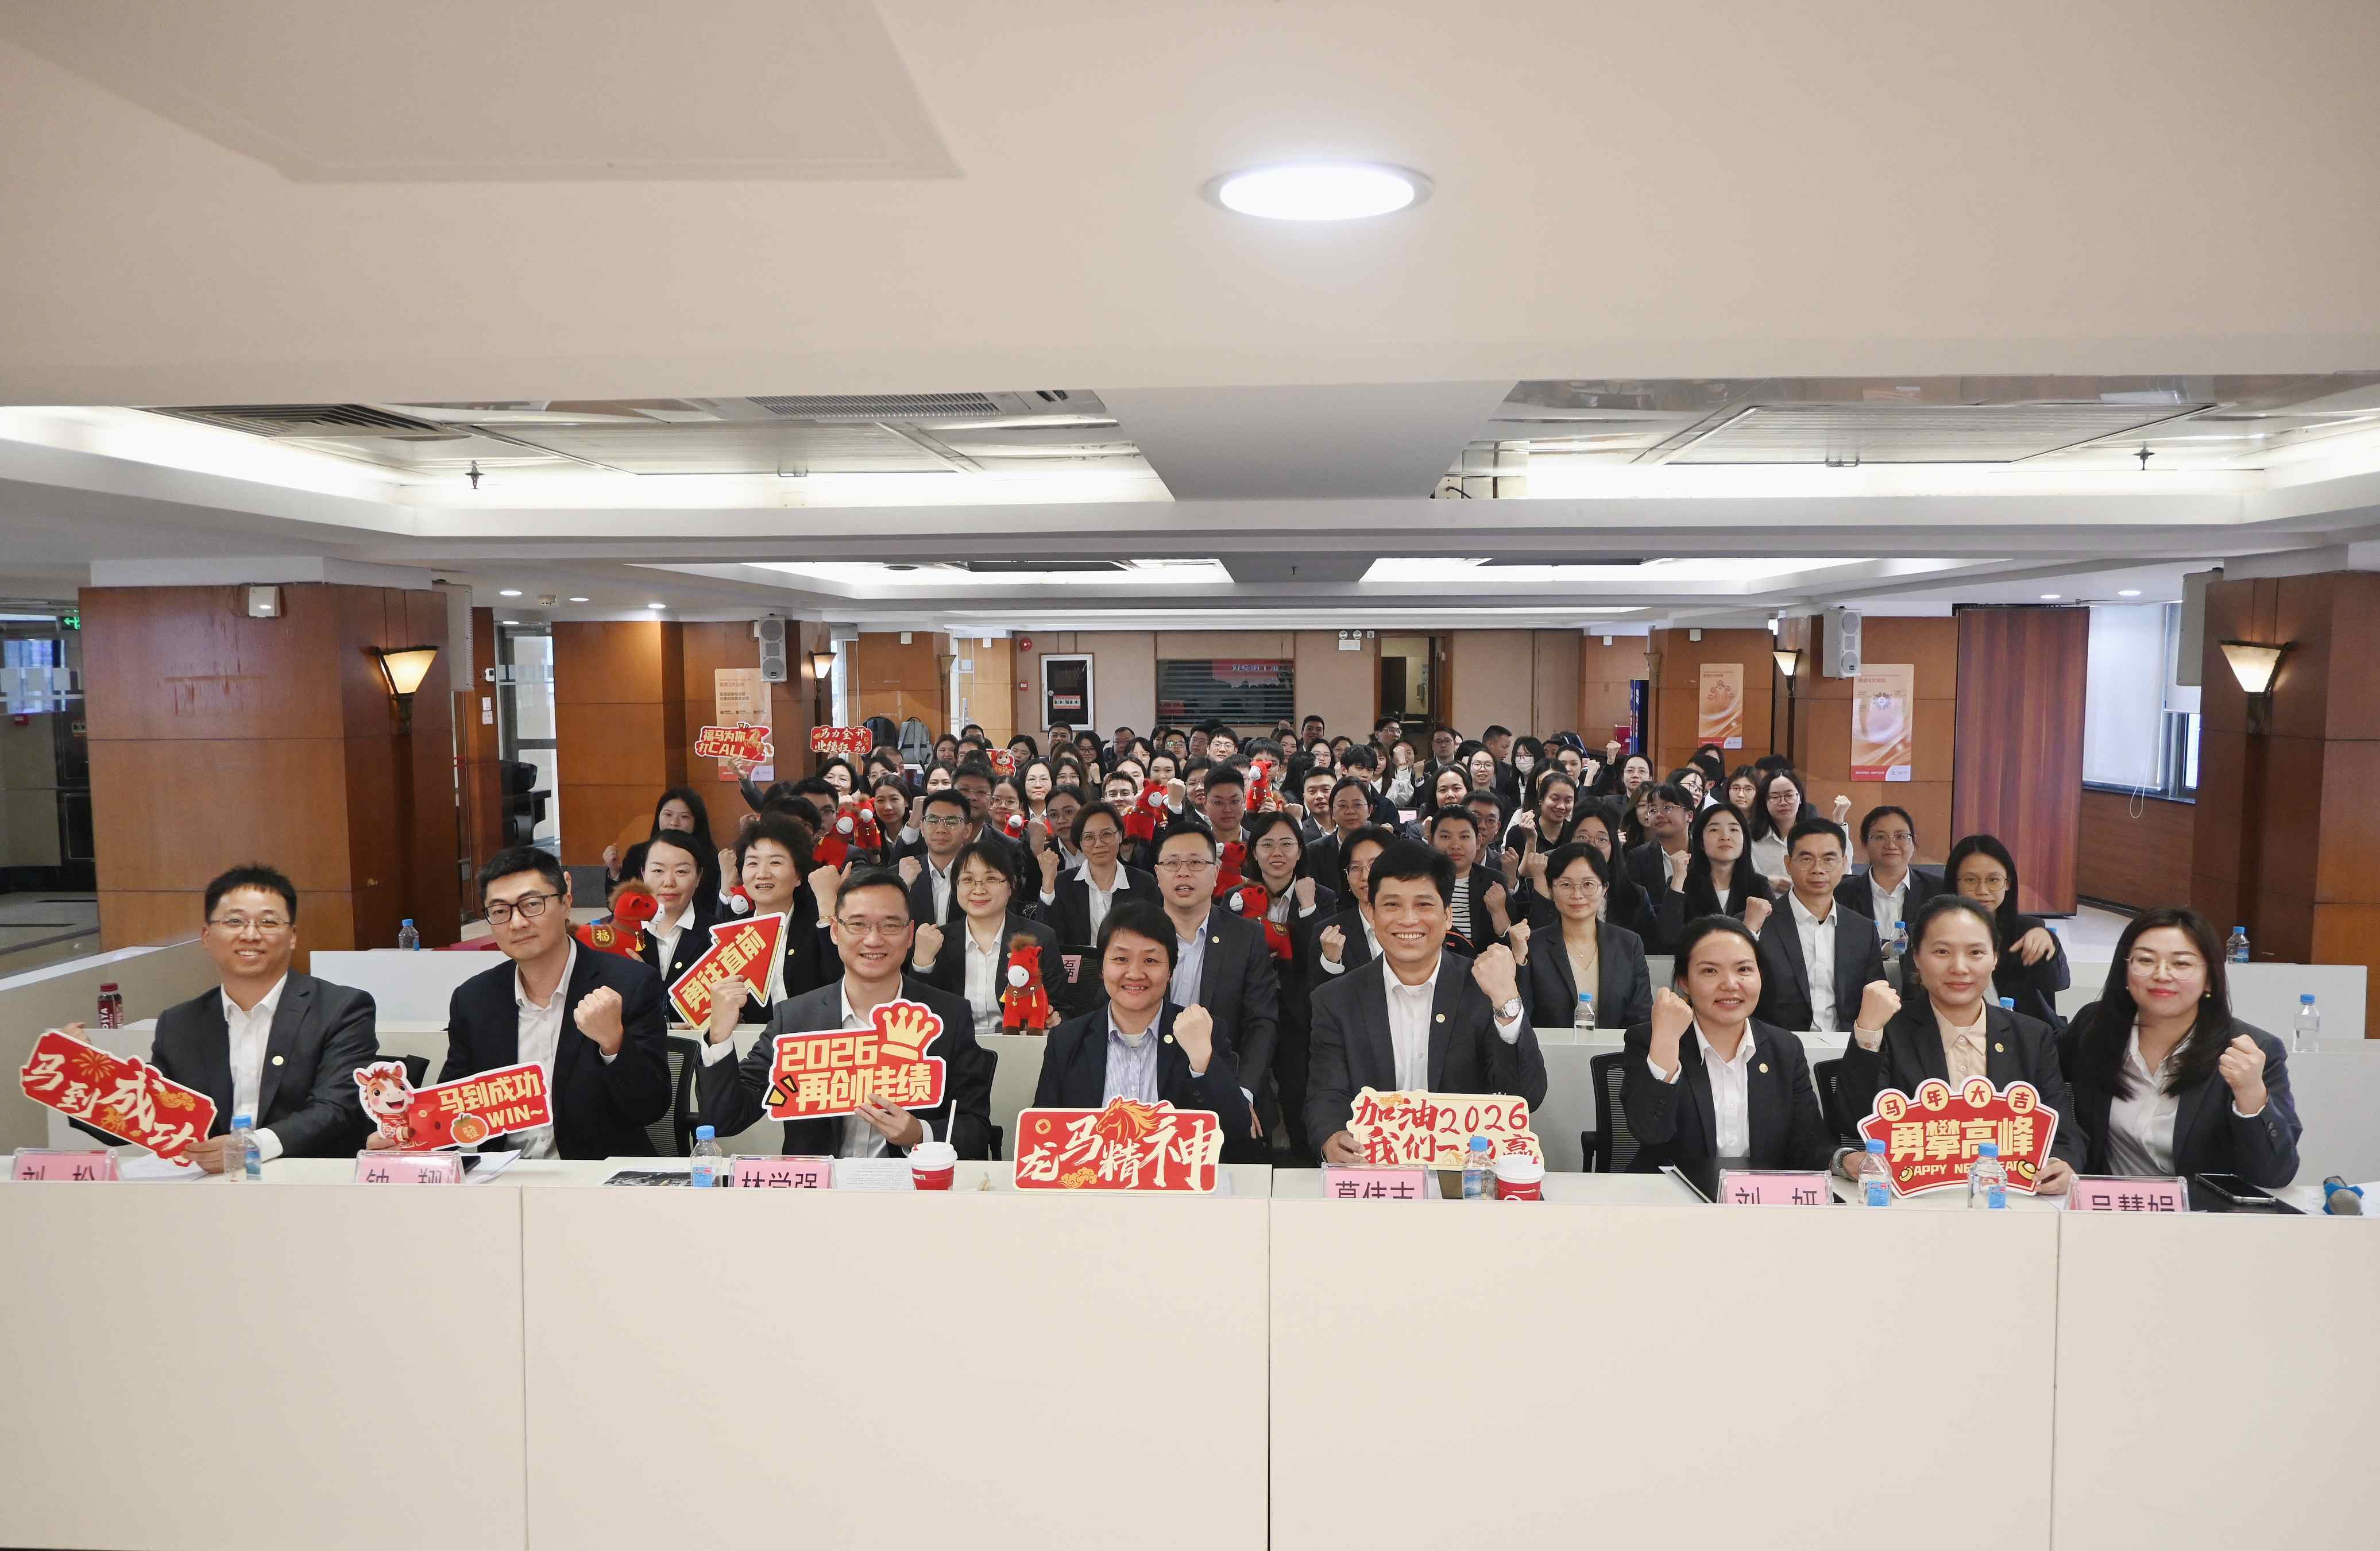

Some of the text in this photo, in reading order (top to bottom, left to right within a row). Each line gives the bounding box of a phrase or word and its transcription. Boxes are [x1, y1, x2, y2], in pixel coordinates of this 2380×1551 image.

[698, 742, 747, 758] 打CALL
[704, 730, 746, 742] 福马为你
[820, 727, 866, 740] 马力全开
[596, 930, 610, 942] 福
[679, 924, 767, 1014] 勇往直前
[782, 1035, 878, 1071] 2026
[438, 1071, 542, 1115] 马到成功
[796, 1063, 931, 1112] 再创佳绩
[1885, 1085, 2030, 1117] 马年大吉
[23, 1053, 198, 1164] 马到成功
[1355, 1095, 1528, 1135] 加油2026
[1017, 1114, 1224, 1191] 龙马精神
[1890, 1116, 2034, 1162] 勇攀高峰
[1905, 1164, 1947, 1176] APPY
[1954, 1163, 1971, 1174] NE
